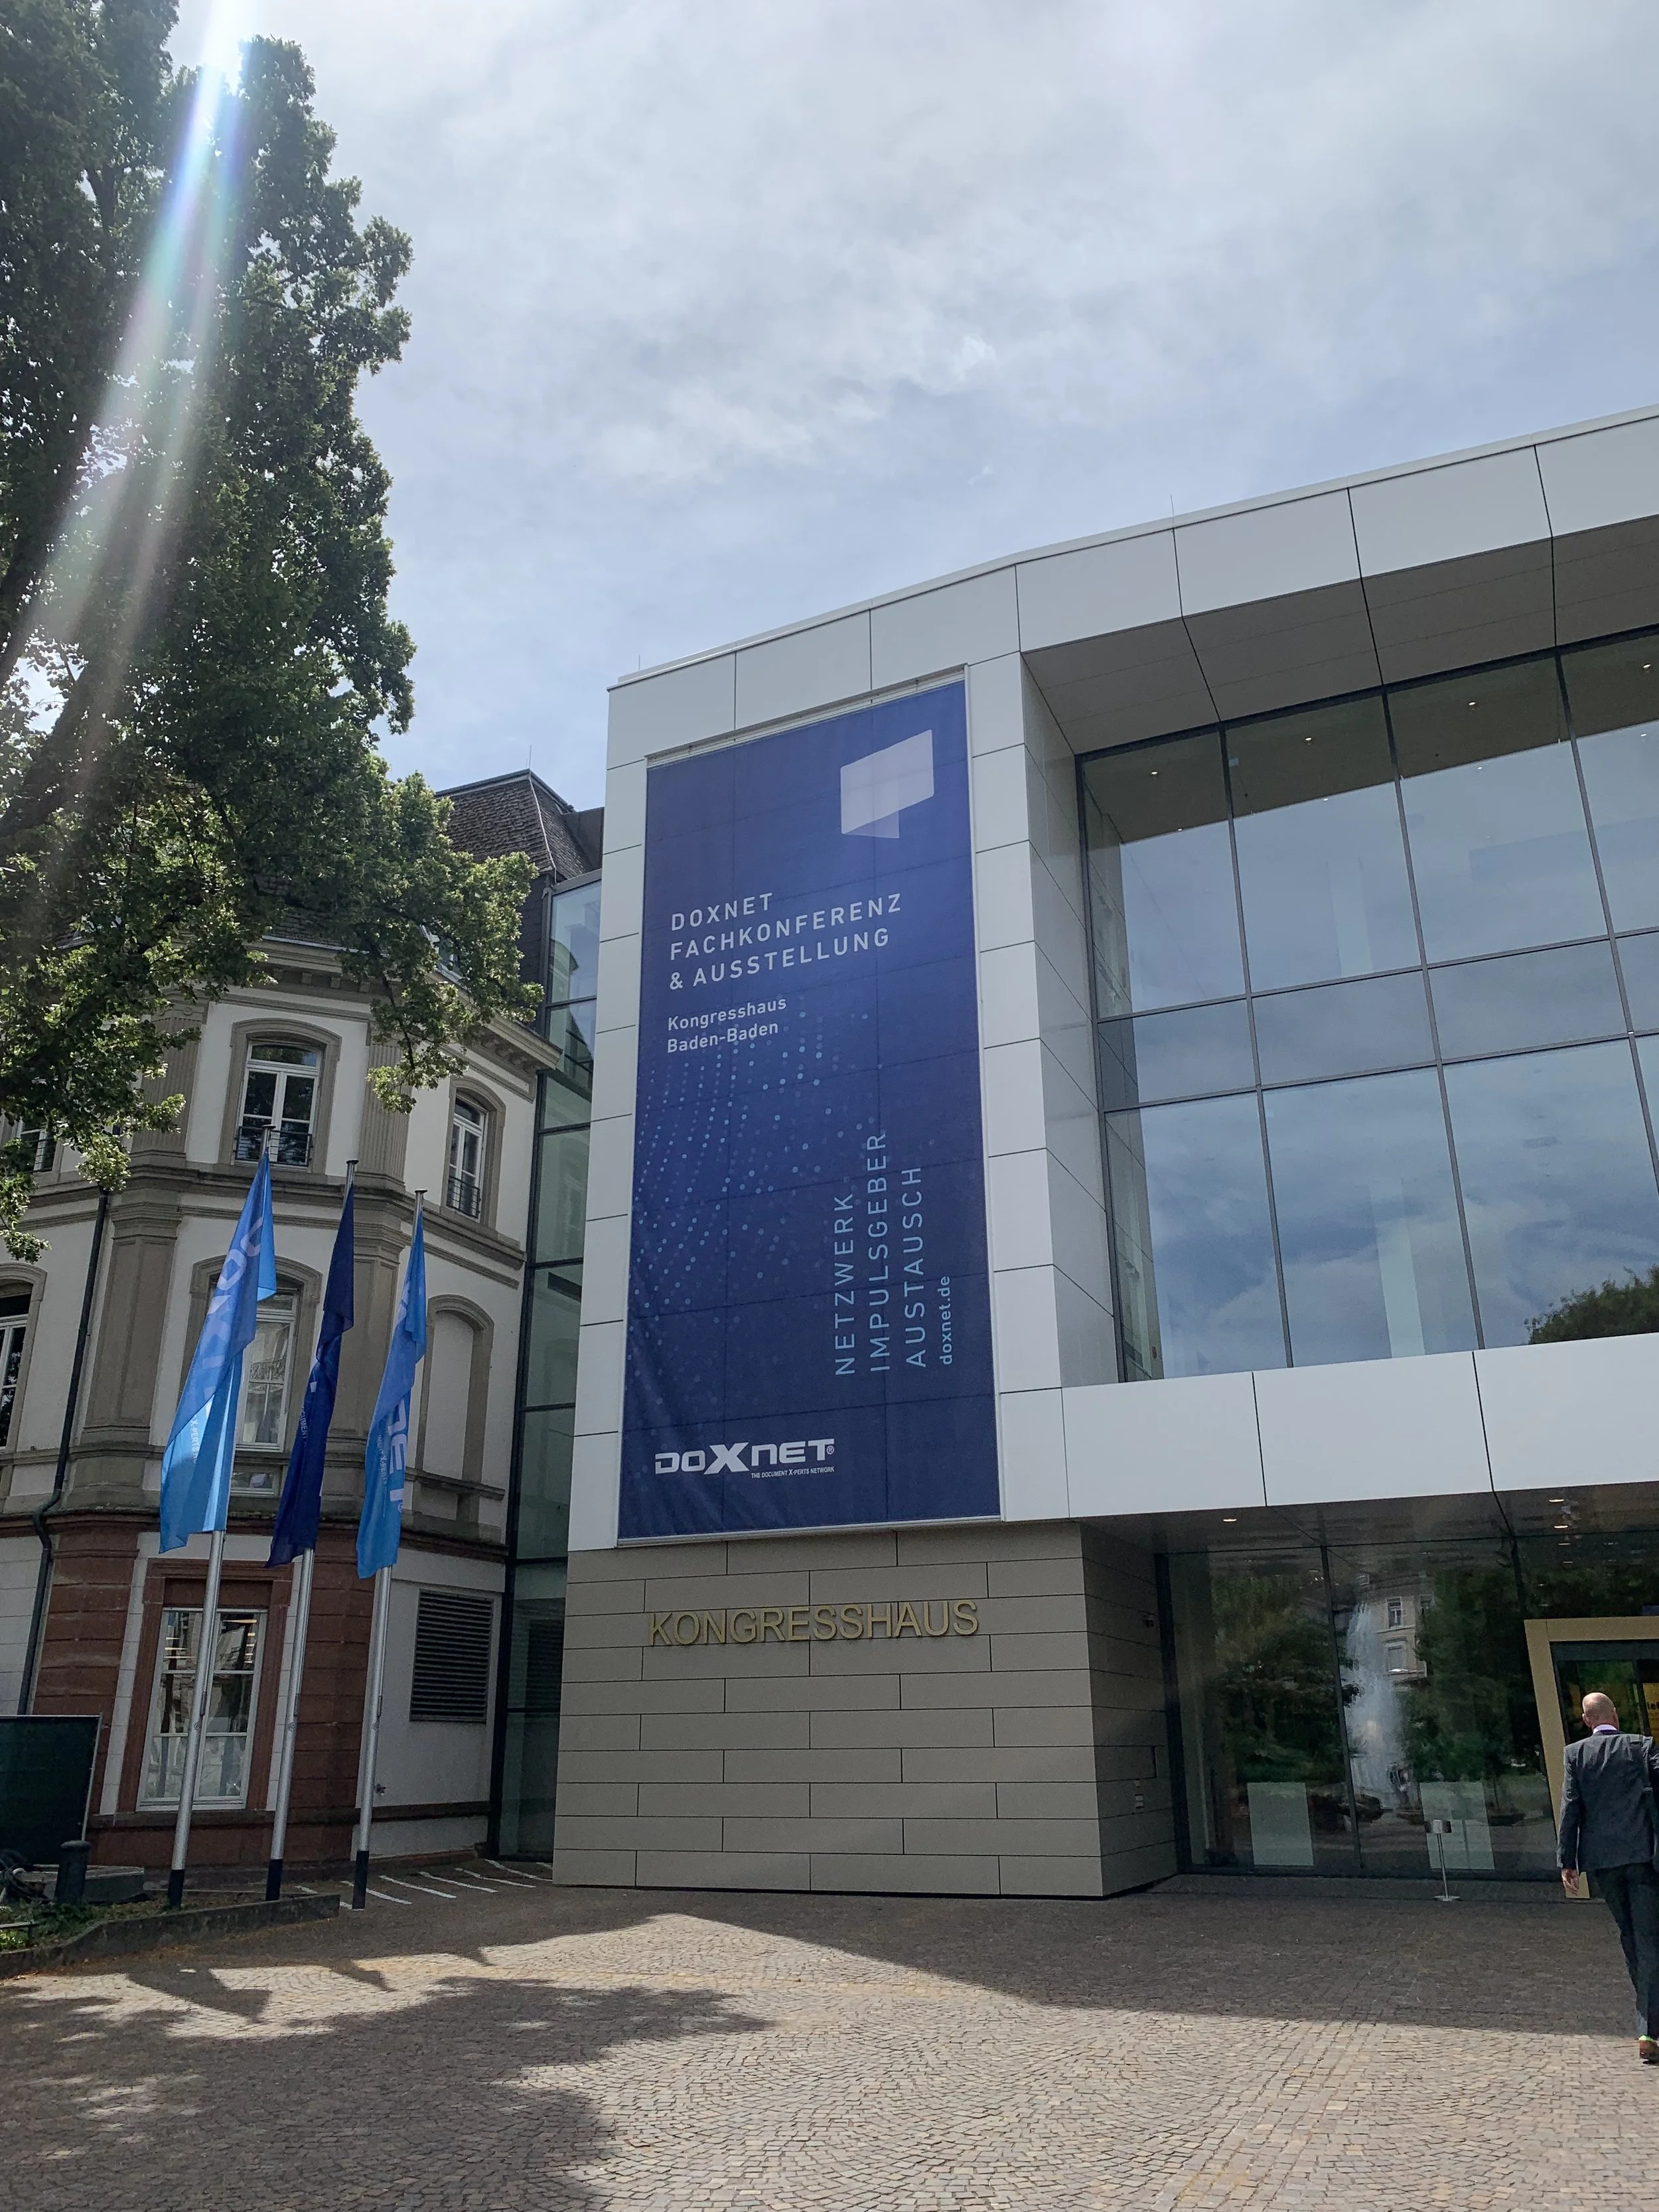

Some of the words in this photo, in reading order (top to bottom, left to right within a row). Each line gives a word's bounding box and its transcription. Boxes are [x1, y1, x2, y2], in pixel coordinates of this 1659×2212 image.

[670, 893, 902, 960] FACHKONFERENZ
[672, 892, 773, 931] DOXNET
[670, 972, 684, 991] &
[692, 928, 889, 988] AUSSTELLUNG
[667, 1021, 778, 1053] Baden-Baden
[668, 997, 787, 1031] Kongresshaus
[867, 1132, 891, 1372] IMPULSGEBER
[901, 1167, 926, 1368] AUSTAUSCH
[833, 1193, 855, 1376] NETZWERK
[938, 1274, 953, 1366] doxnet.de
[761, 1469, 788, 1478] DOCUMENT
[648, 1598, 979, 1647] KONGRESSHAUS
